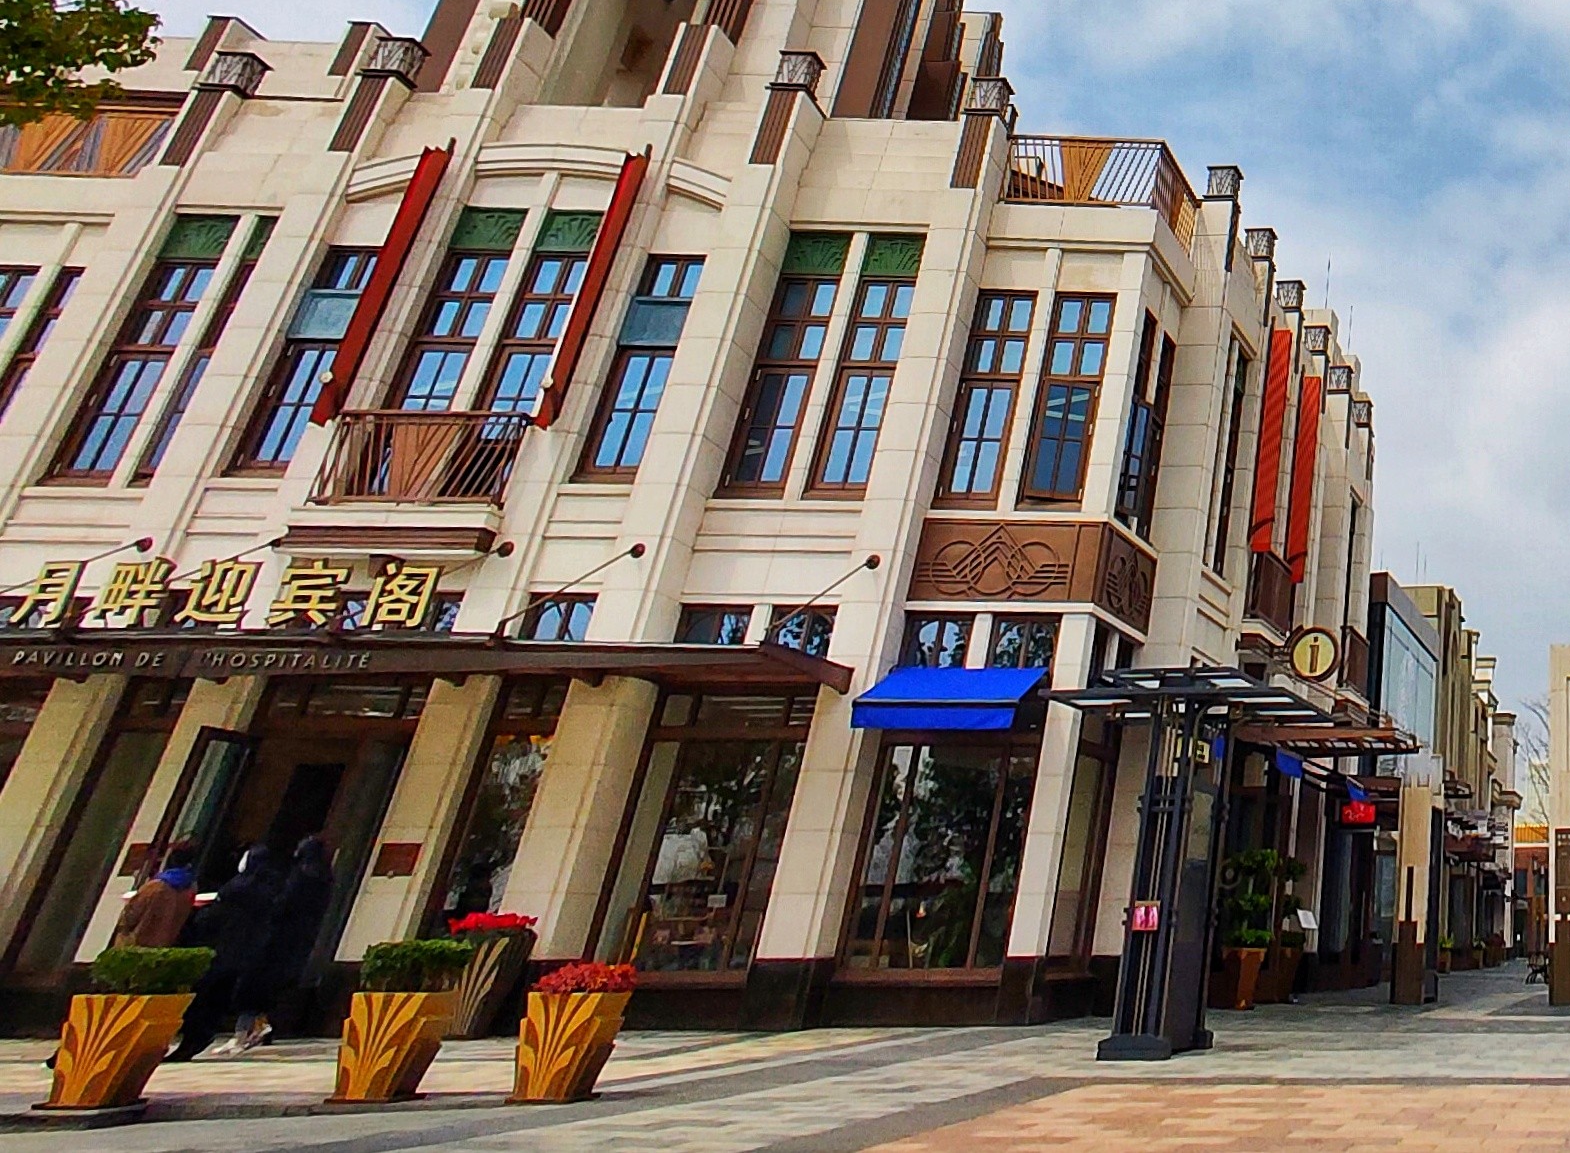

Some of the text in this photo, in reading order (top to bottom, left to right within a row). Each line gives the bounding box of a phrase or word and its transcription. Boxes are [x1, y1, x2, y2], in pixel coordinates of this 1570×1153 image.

[9, 558, 438, 628] 月畔迎宾阁
[12, 651, 124, 666] PAVILLON
[134, 651, 164, 667] DE
